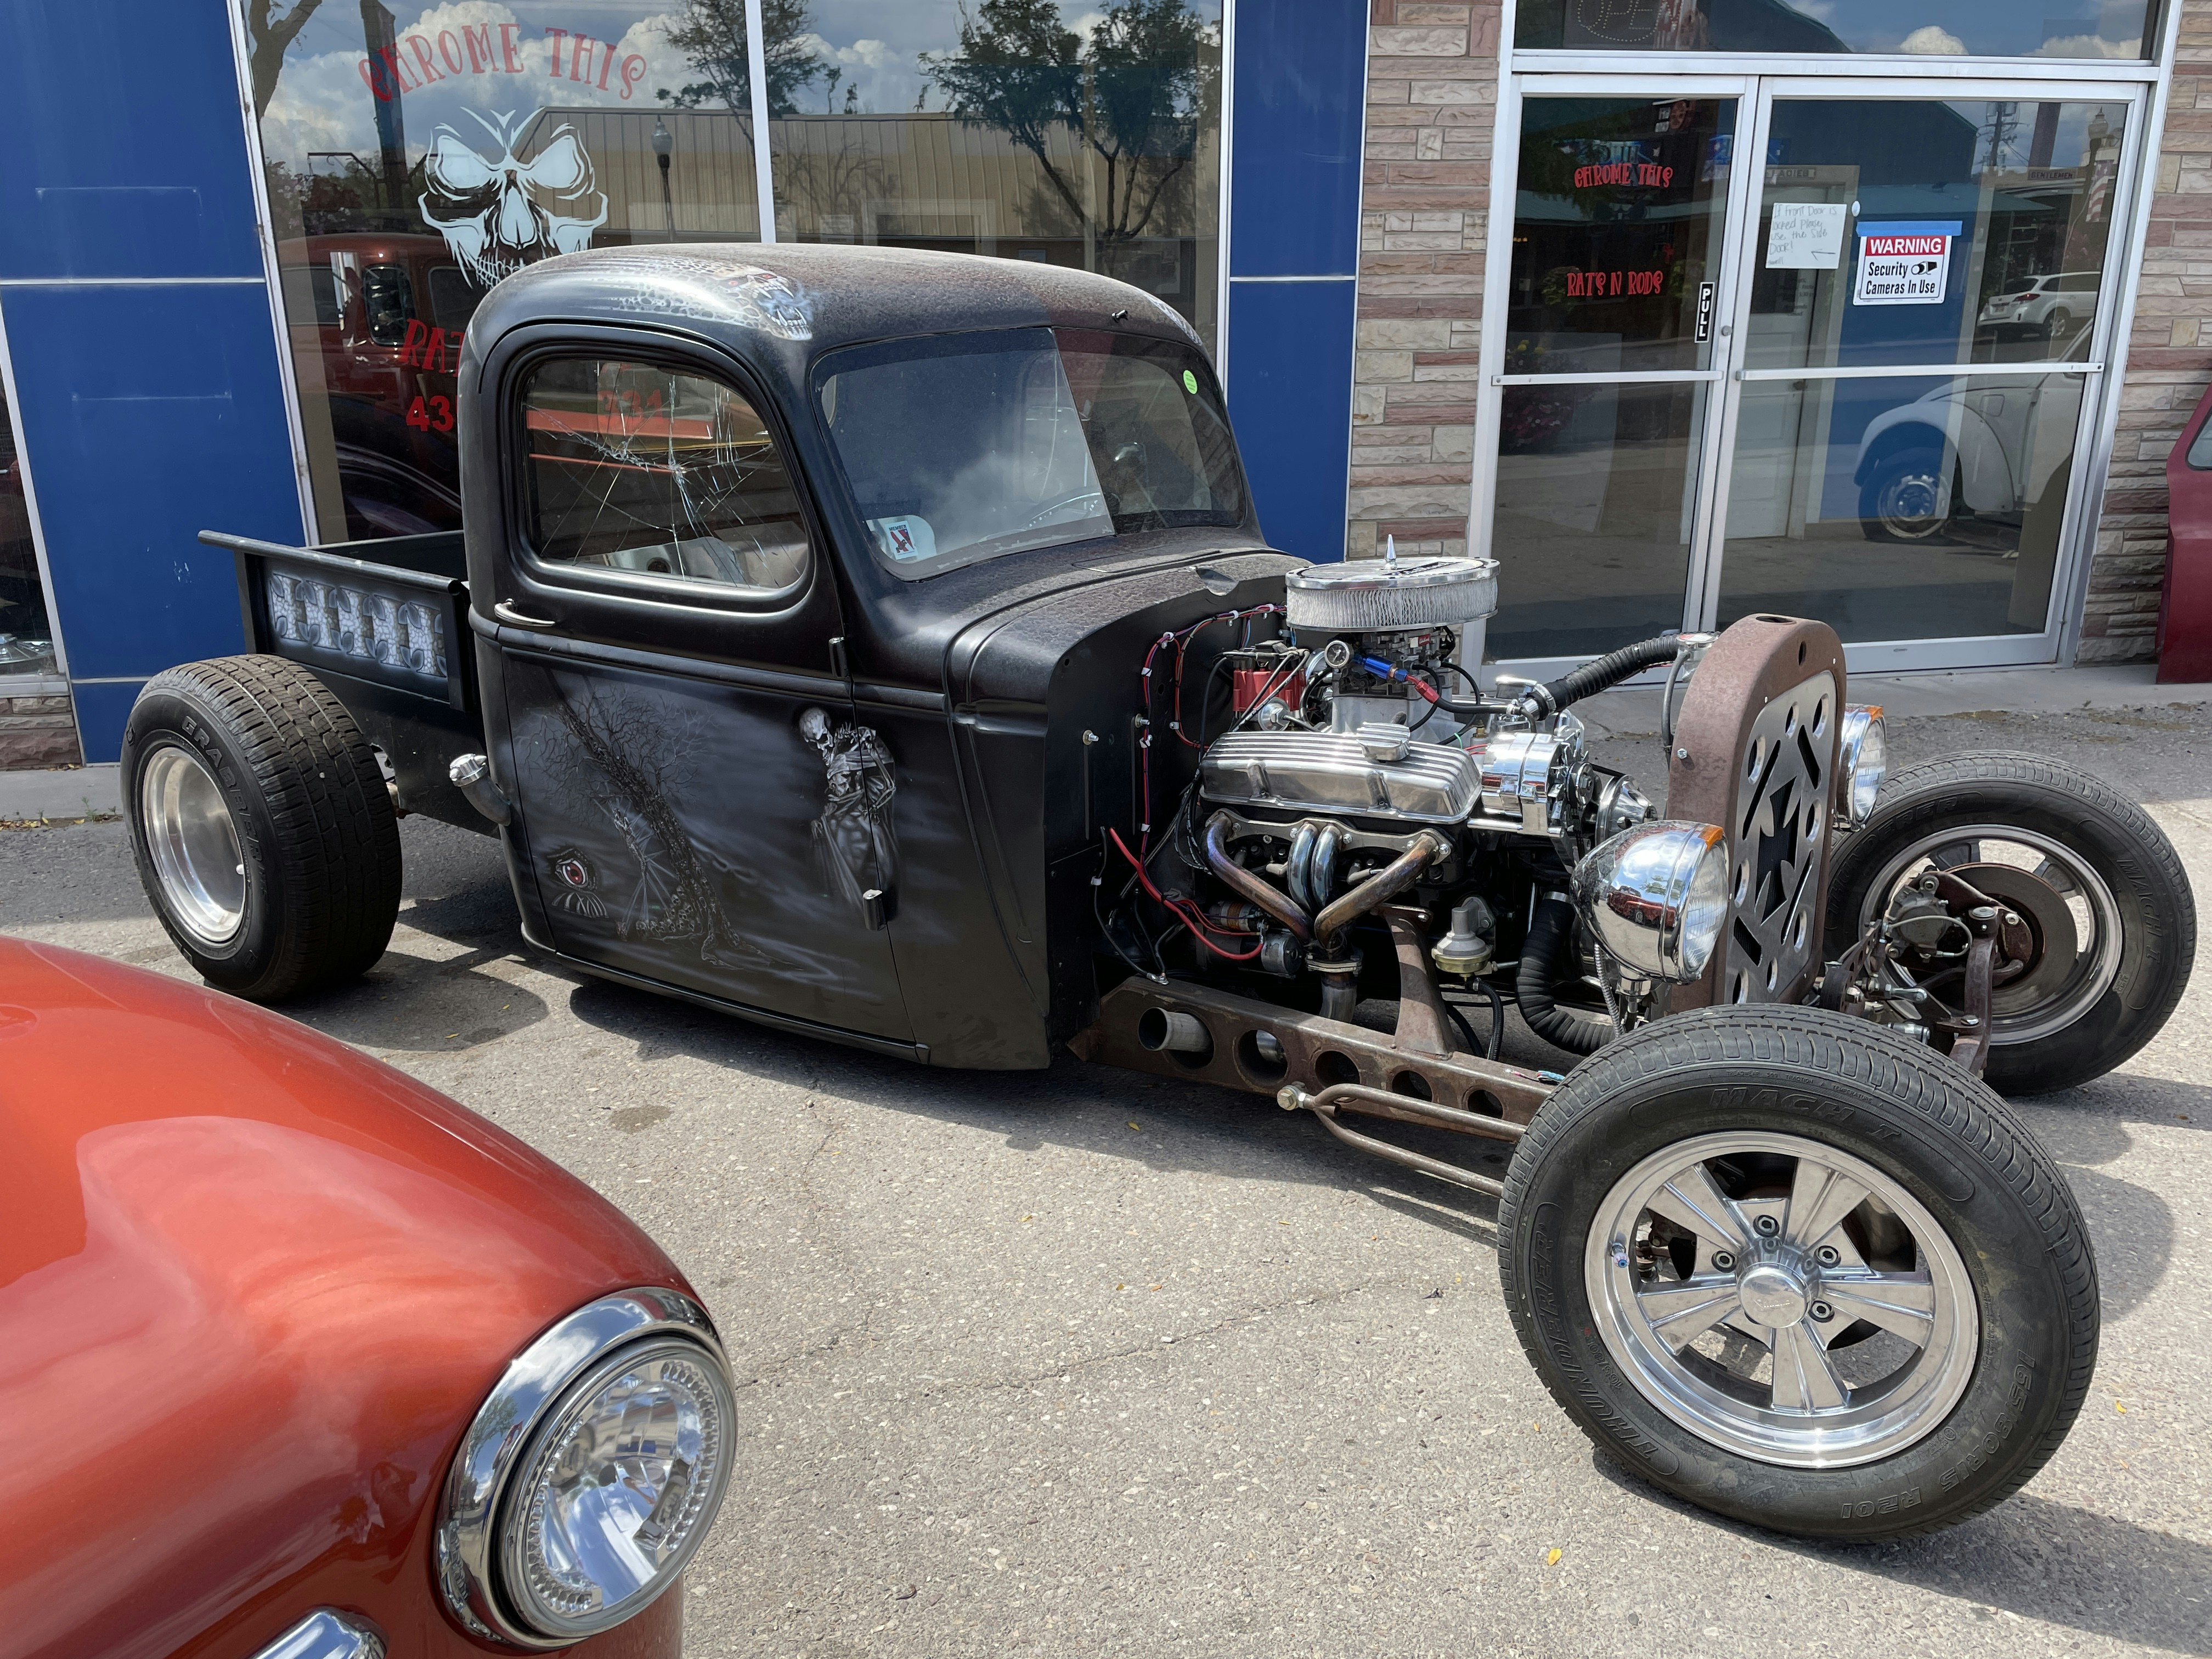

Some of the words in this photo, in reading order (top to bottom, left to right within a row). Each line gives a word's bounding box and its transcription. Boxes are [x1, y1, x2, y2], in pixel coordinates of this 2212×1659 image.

[358, 22, 524, 103] CHROME
[545, 26, 647, 100] THIS
[1573, 163, 1632, 189] CHROME
[1638, 163, 1674, 189] THIS
[1870, 238, 1942, 254] WARNING
[1610, 270, 1623, 296] N
[1627, 270, 1663, 295] RODS
[1869, 261, 1909, 279] Security
[1866, 280, 1905, 295] Cameras
[1908, 280, 1916, 294] In
[1919, 279, 1936, 294] Use
[1699, 288, 1711, 337] PULL
[405, 395, 459, 432] 43
[182, 715, 263, 861] GRABBER
[1786, 1074, 1814, 1084] TRACTION
[1832, 1085, 1874, 1103] TEMPERATURE
[1709, 1087, 1855, 1124] MACH
[1532, 1232, 1658, 1459] THUNDERER
